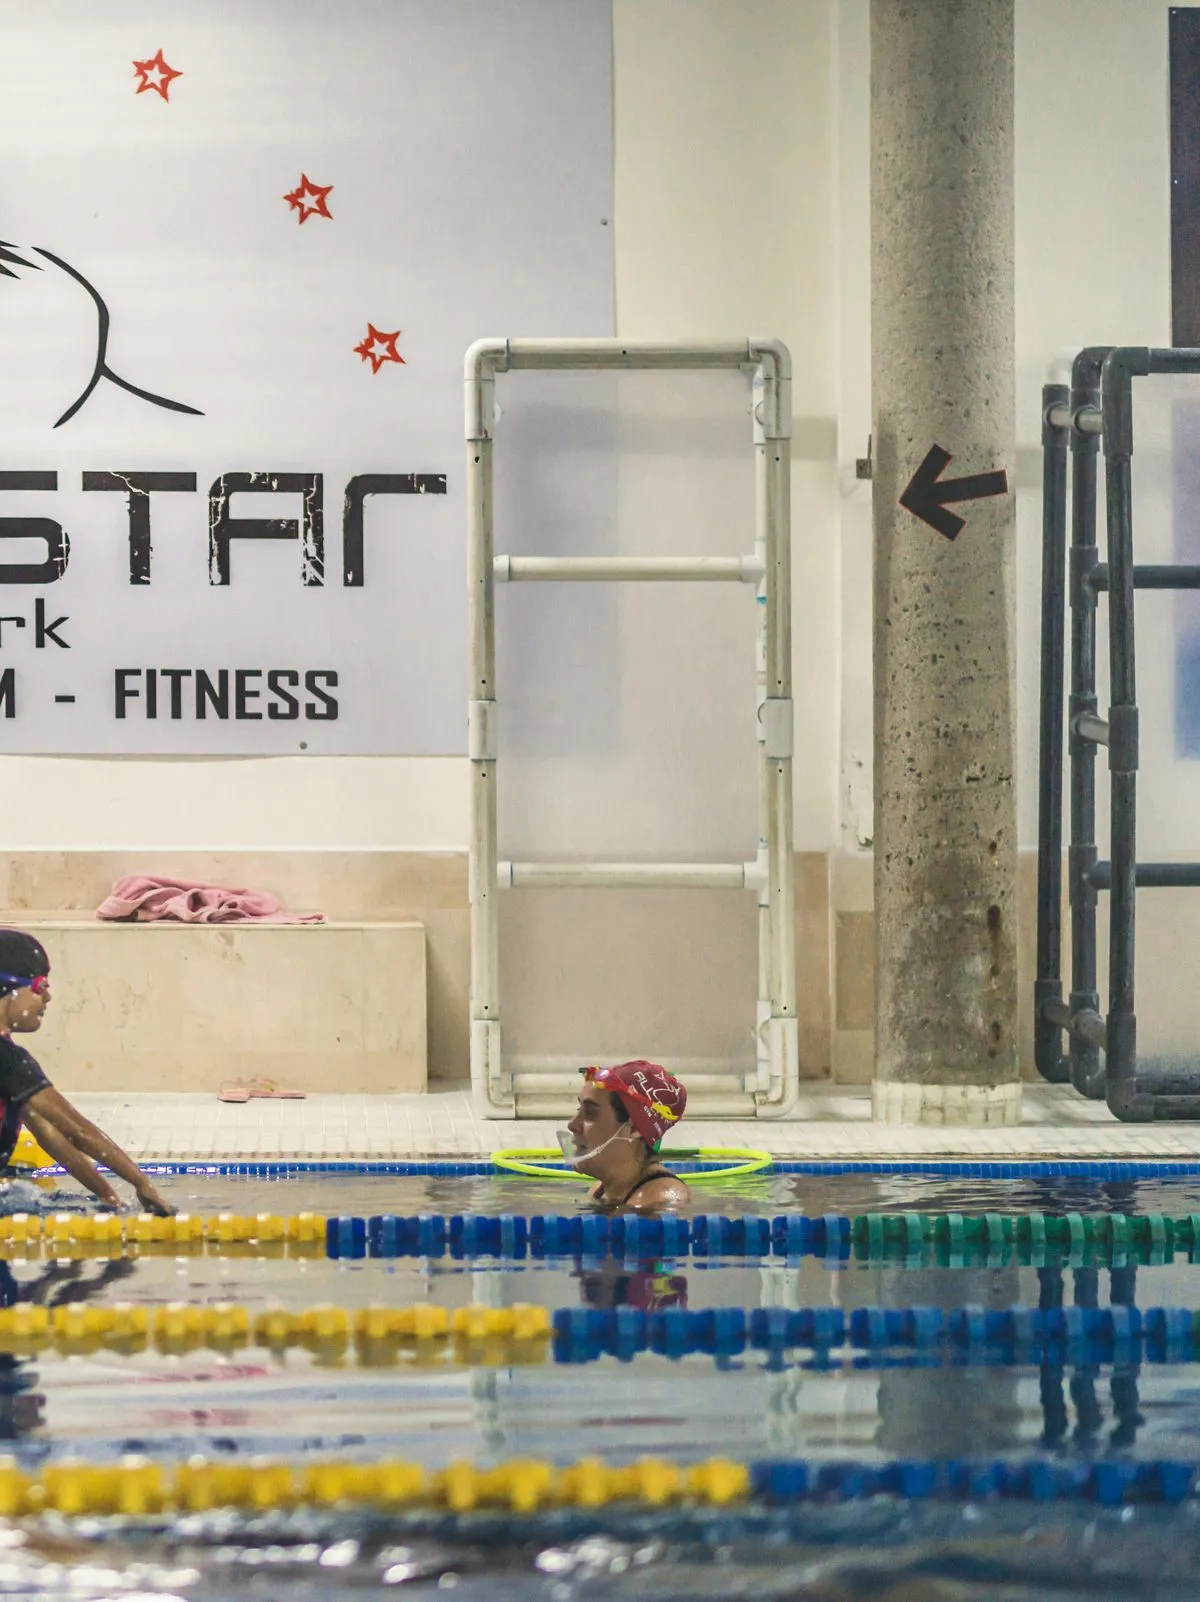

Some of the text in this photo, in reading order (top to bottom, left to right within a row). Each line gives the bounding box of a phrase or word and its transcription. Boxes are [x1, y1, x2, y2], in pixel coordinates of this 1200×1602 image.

[55, 695, 75, 704] -
[115, 668, 339, 721] FITNESS
[634, 1072, 652, 1100] ALL
